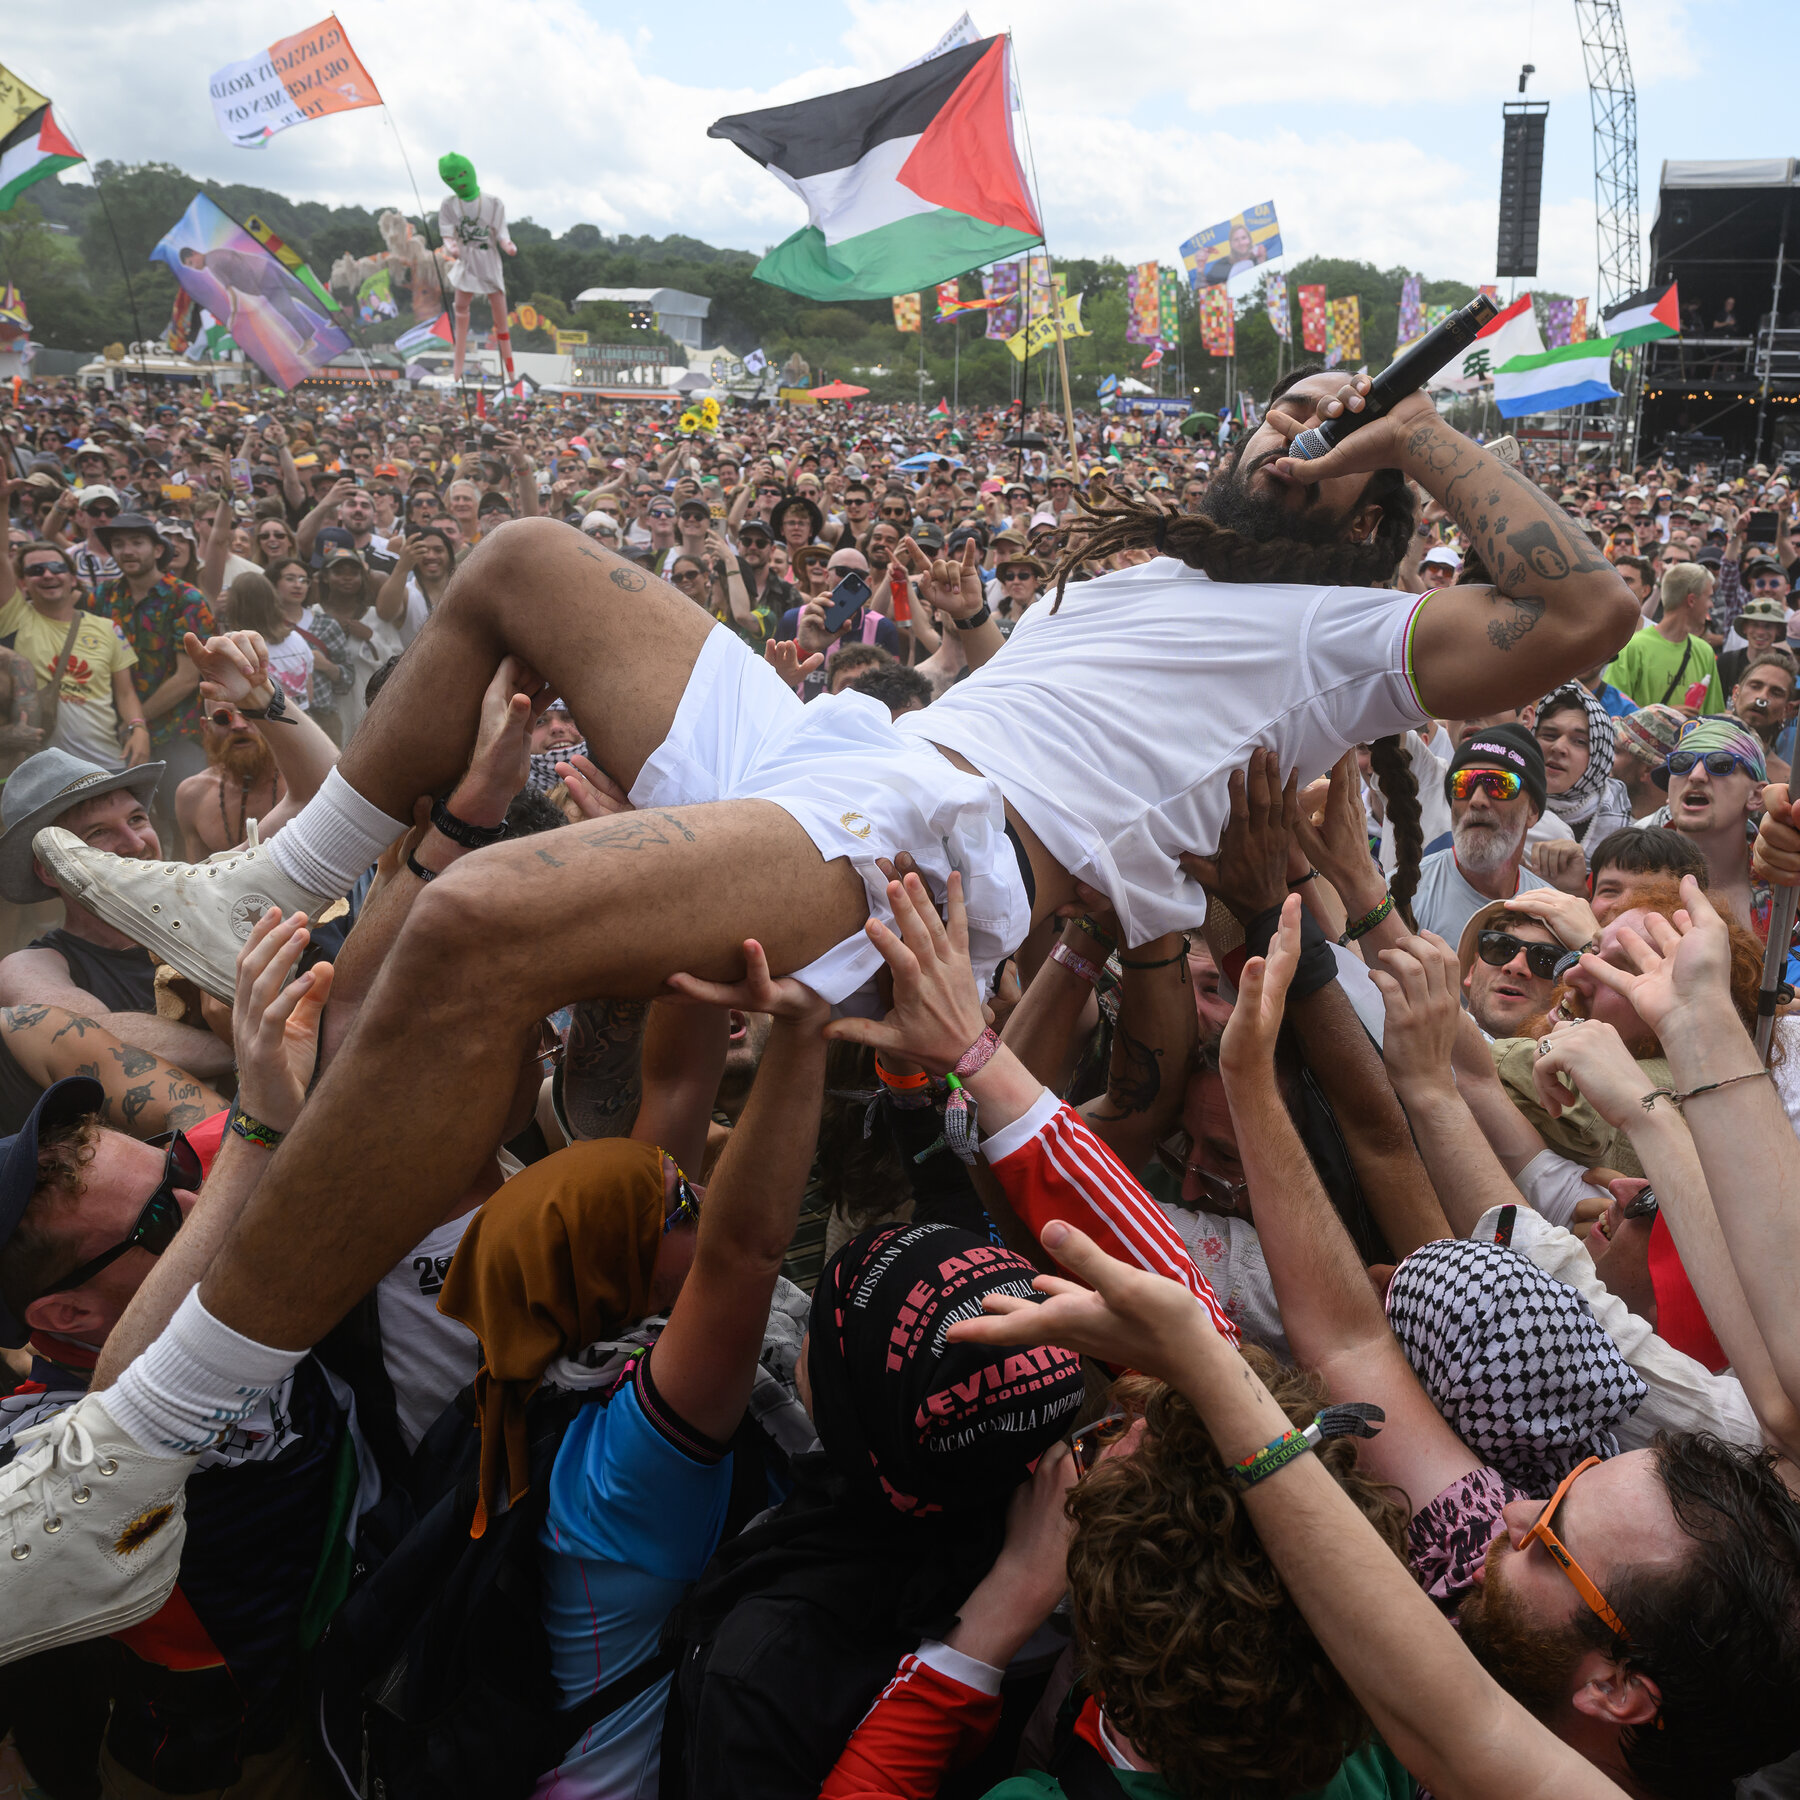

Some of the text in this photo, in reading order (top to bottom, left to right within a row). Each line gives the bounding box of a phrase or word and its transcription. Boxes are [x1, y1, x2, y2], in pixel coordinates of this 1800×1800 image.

[853, 1246, 902, 1309] RUSSIAN
[886, 1280, 936, 1373] THE
[907, 1301, 938, 1360] AGED
[941, 1276, 968, 1298] ON
[984, 1365, 1075, 1405] BOURBON
